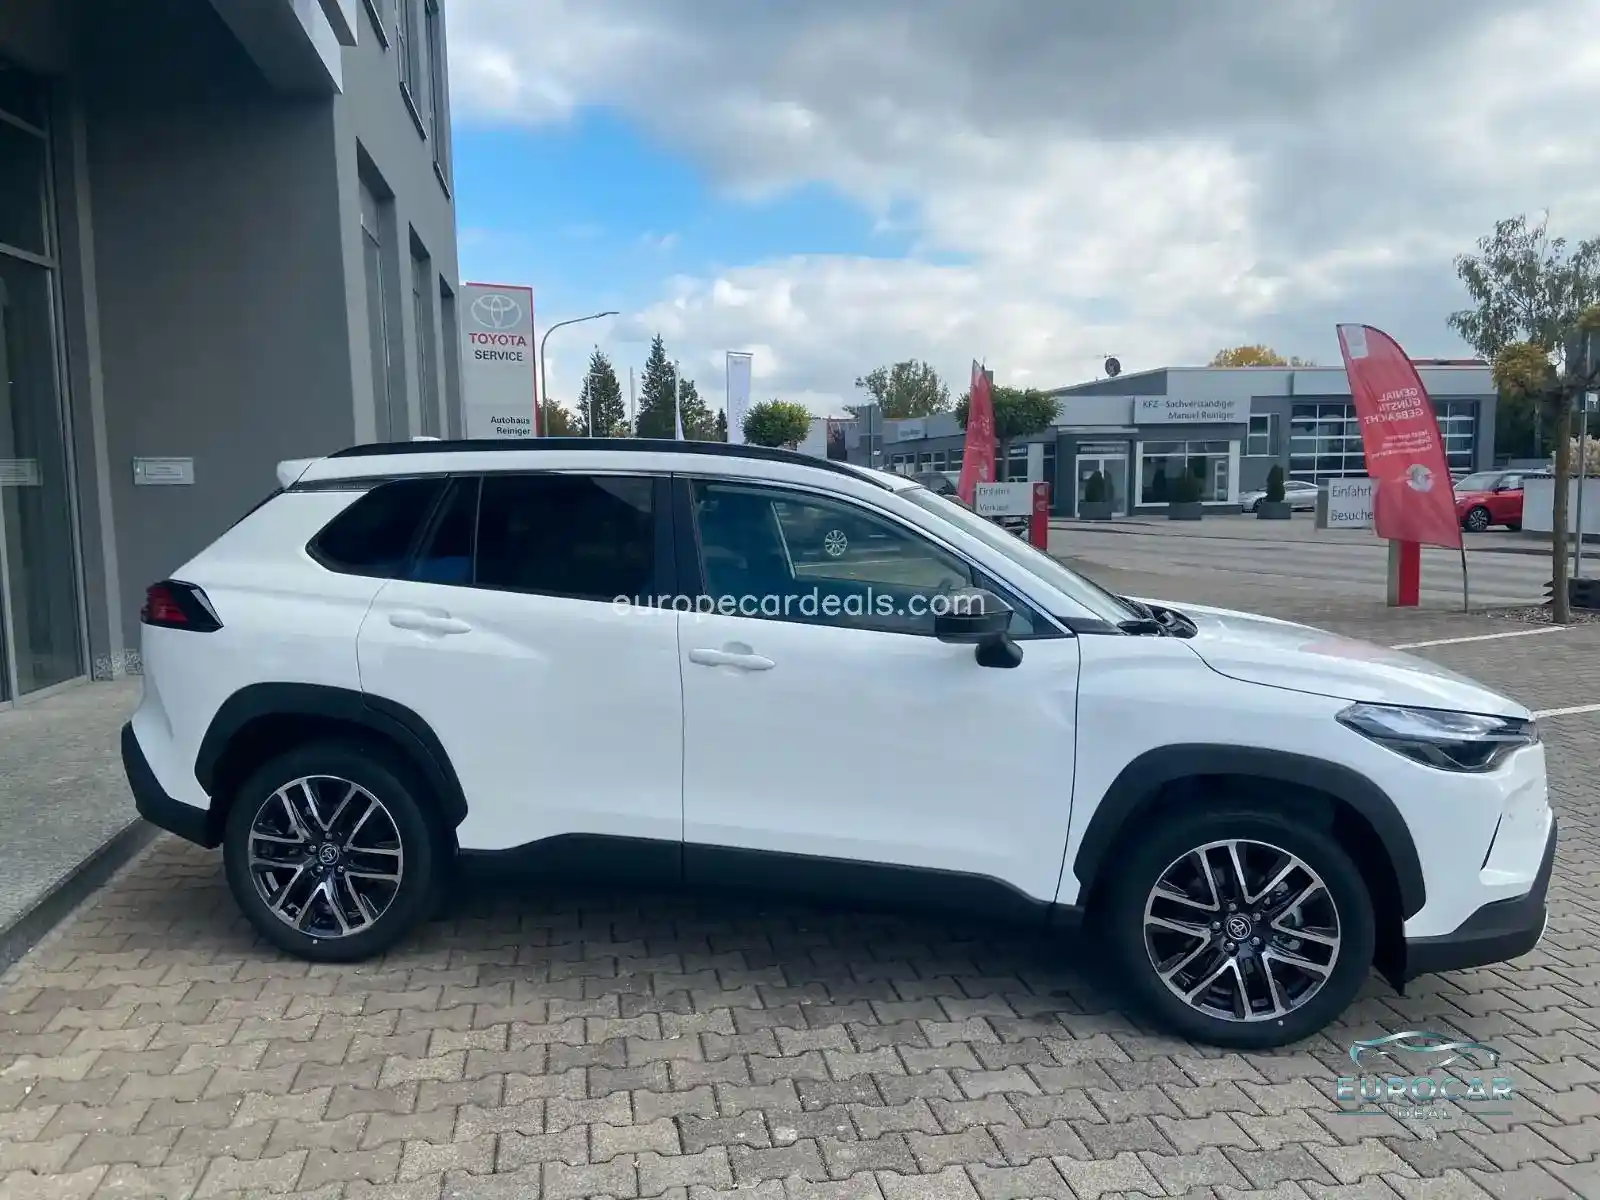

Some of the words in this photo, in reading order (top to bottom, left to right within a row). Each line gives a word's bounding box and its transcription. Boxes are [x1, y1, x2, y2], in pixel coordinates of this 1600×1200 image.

[469, 332, 527, 346] TOYOTA
[474, 349, 523, 361] SERVICE
[1142, 400, 1159, 409] KFZ
[490, 415, 530, 425] Autohaus
[1168, 411, 1199, 420] Manuel
[496, 426, 531, 436] Reiniger
[1332, 485, 1371, 497] Einfahrt
[1331, 509, 1373, 521] Besuche
